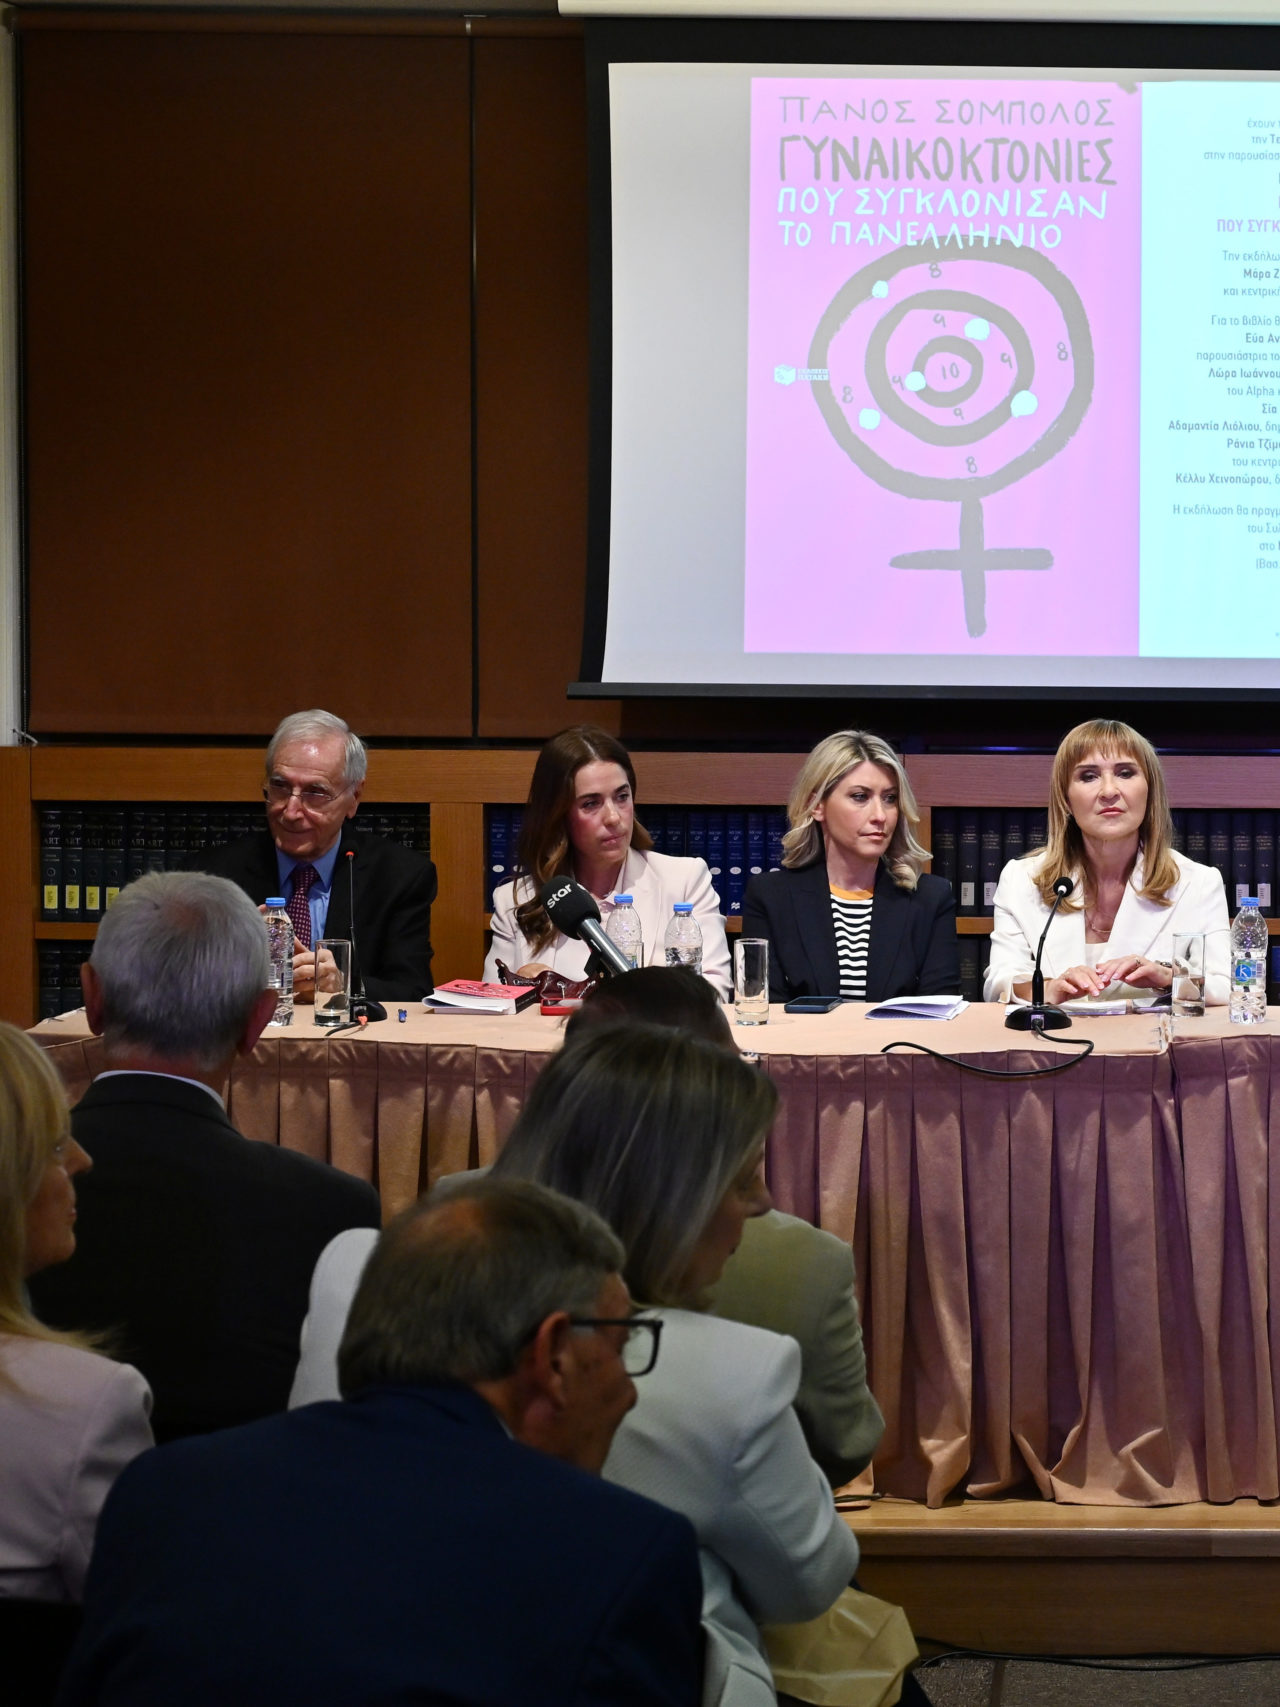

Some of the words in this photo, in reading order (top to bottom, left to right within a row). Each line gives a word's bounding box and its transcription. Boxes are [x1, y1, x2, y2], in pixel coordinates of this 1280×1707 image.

[778, 95, 916, 124] ΠΑΝΟΣ
[935, 98, 1115, 126] ΣΟΜΠΟΛΟΣ
[778, 134, 1118, 186] ΓΥΝΑΙΚΟΚΤΟΝΙΕΣ
[777, 187, 844, 214] ΠΟΥ
[854, 187, 1108, 220] ΣΥΓΚΛΟΝΙΣΑΝ
[778, 221, 811, 247] ΤΟ
[830, 221, 1063, 250] ΠΑΝΕΛΛΗΝΙΟ
[1056, 342, 1069, 361] 8
[941, 362, 960, 379] 10
[841, 386, 854, 404] 8
[966, 456, 978, 474] 8
[546, 882, 572, 909] star
